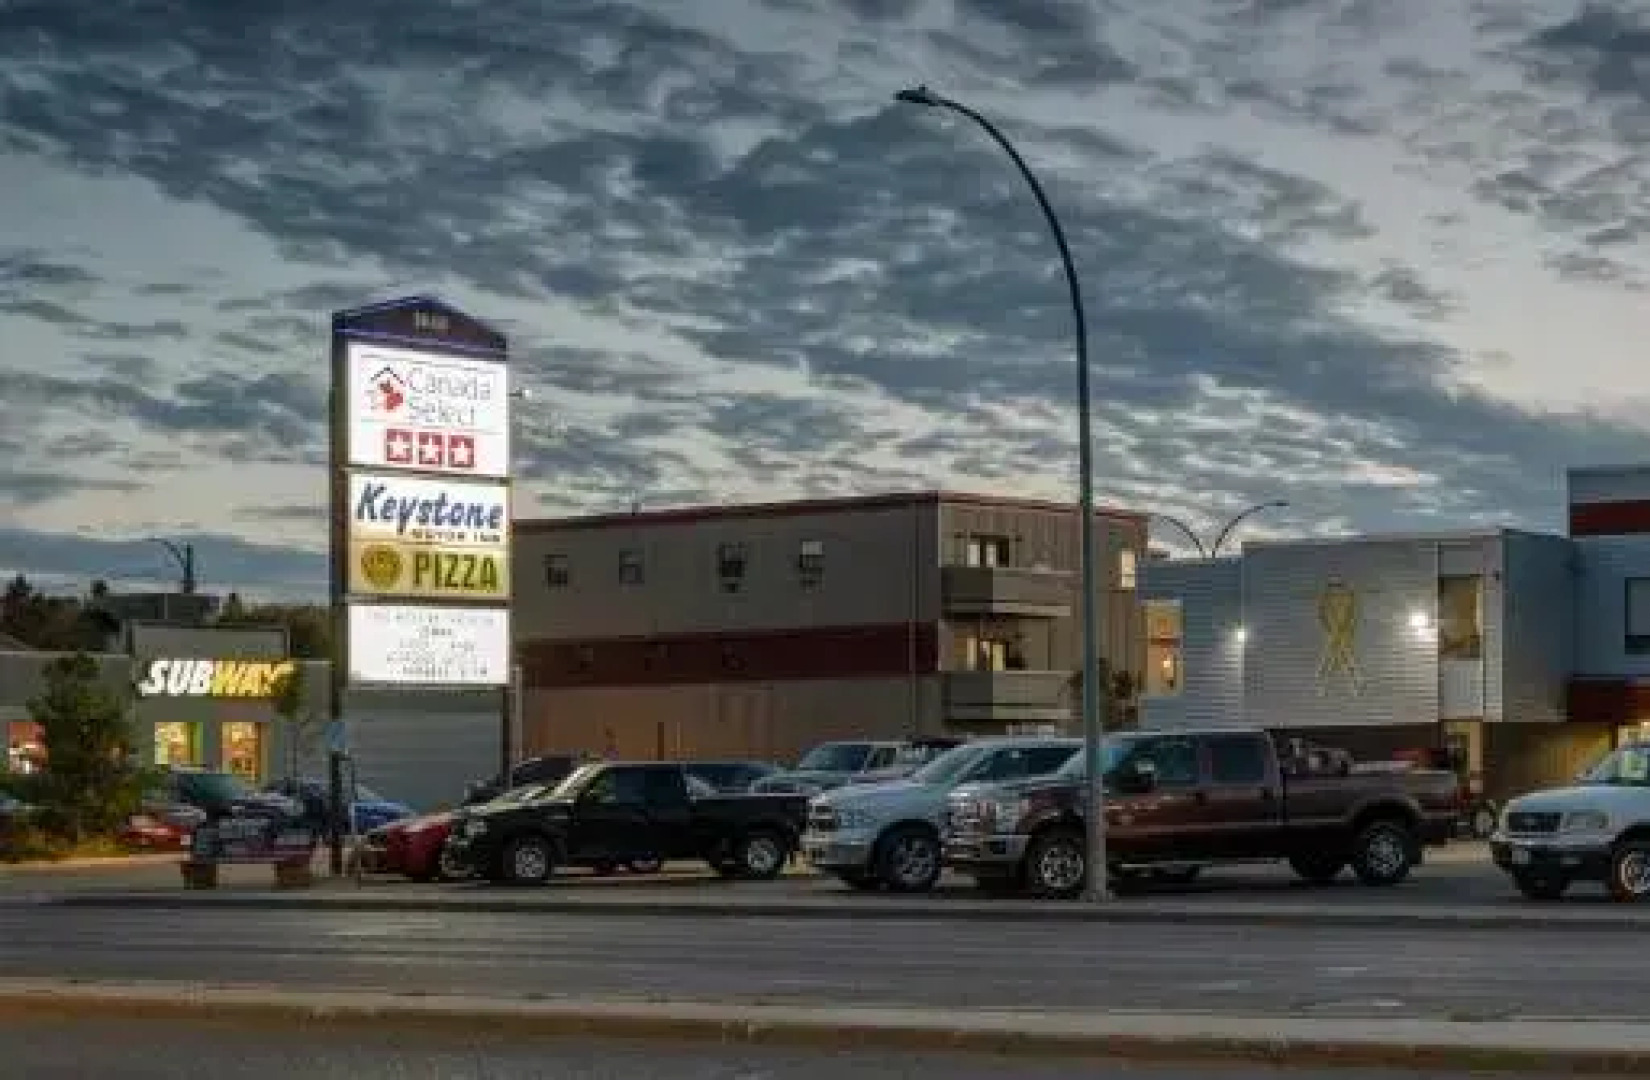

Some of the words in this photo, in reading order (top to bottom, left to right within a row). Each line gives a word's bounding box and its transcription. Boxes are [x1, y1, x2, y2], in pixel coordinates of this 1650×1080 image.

[406, 366, 492, 401] Canada
[407, 398, 476, 427] Select
[356, 482, 504, 535] Keystone
[414, 553, 498, 592] PIZZA
[137, 659, 295, 697] SUBWAY
